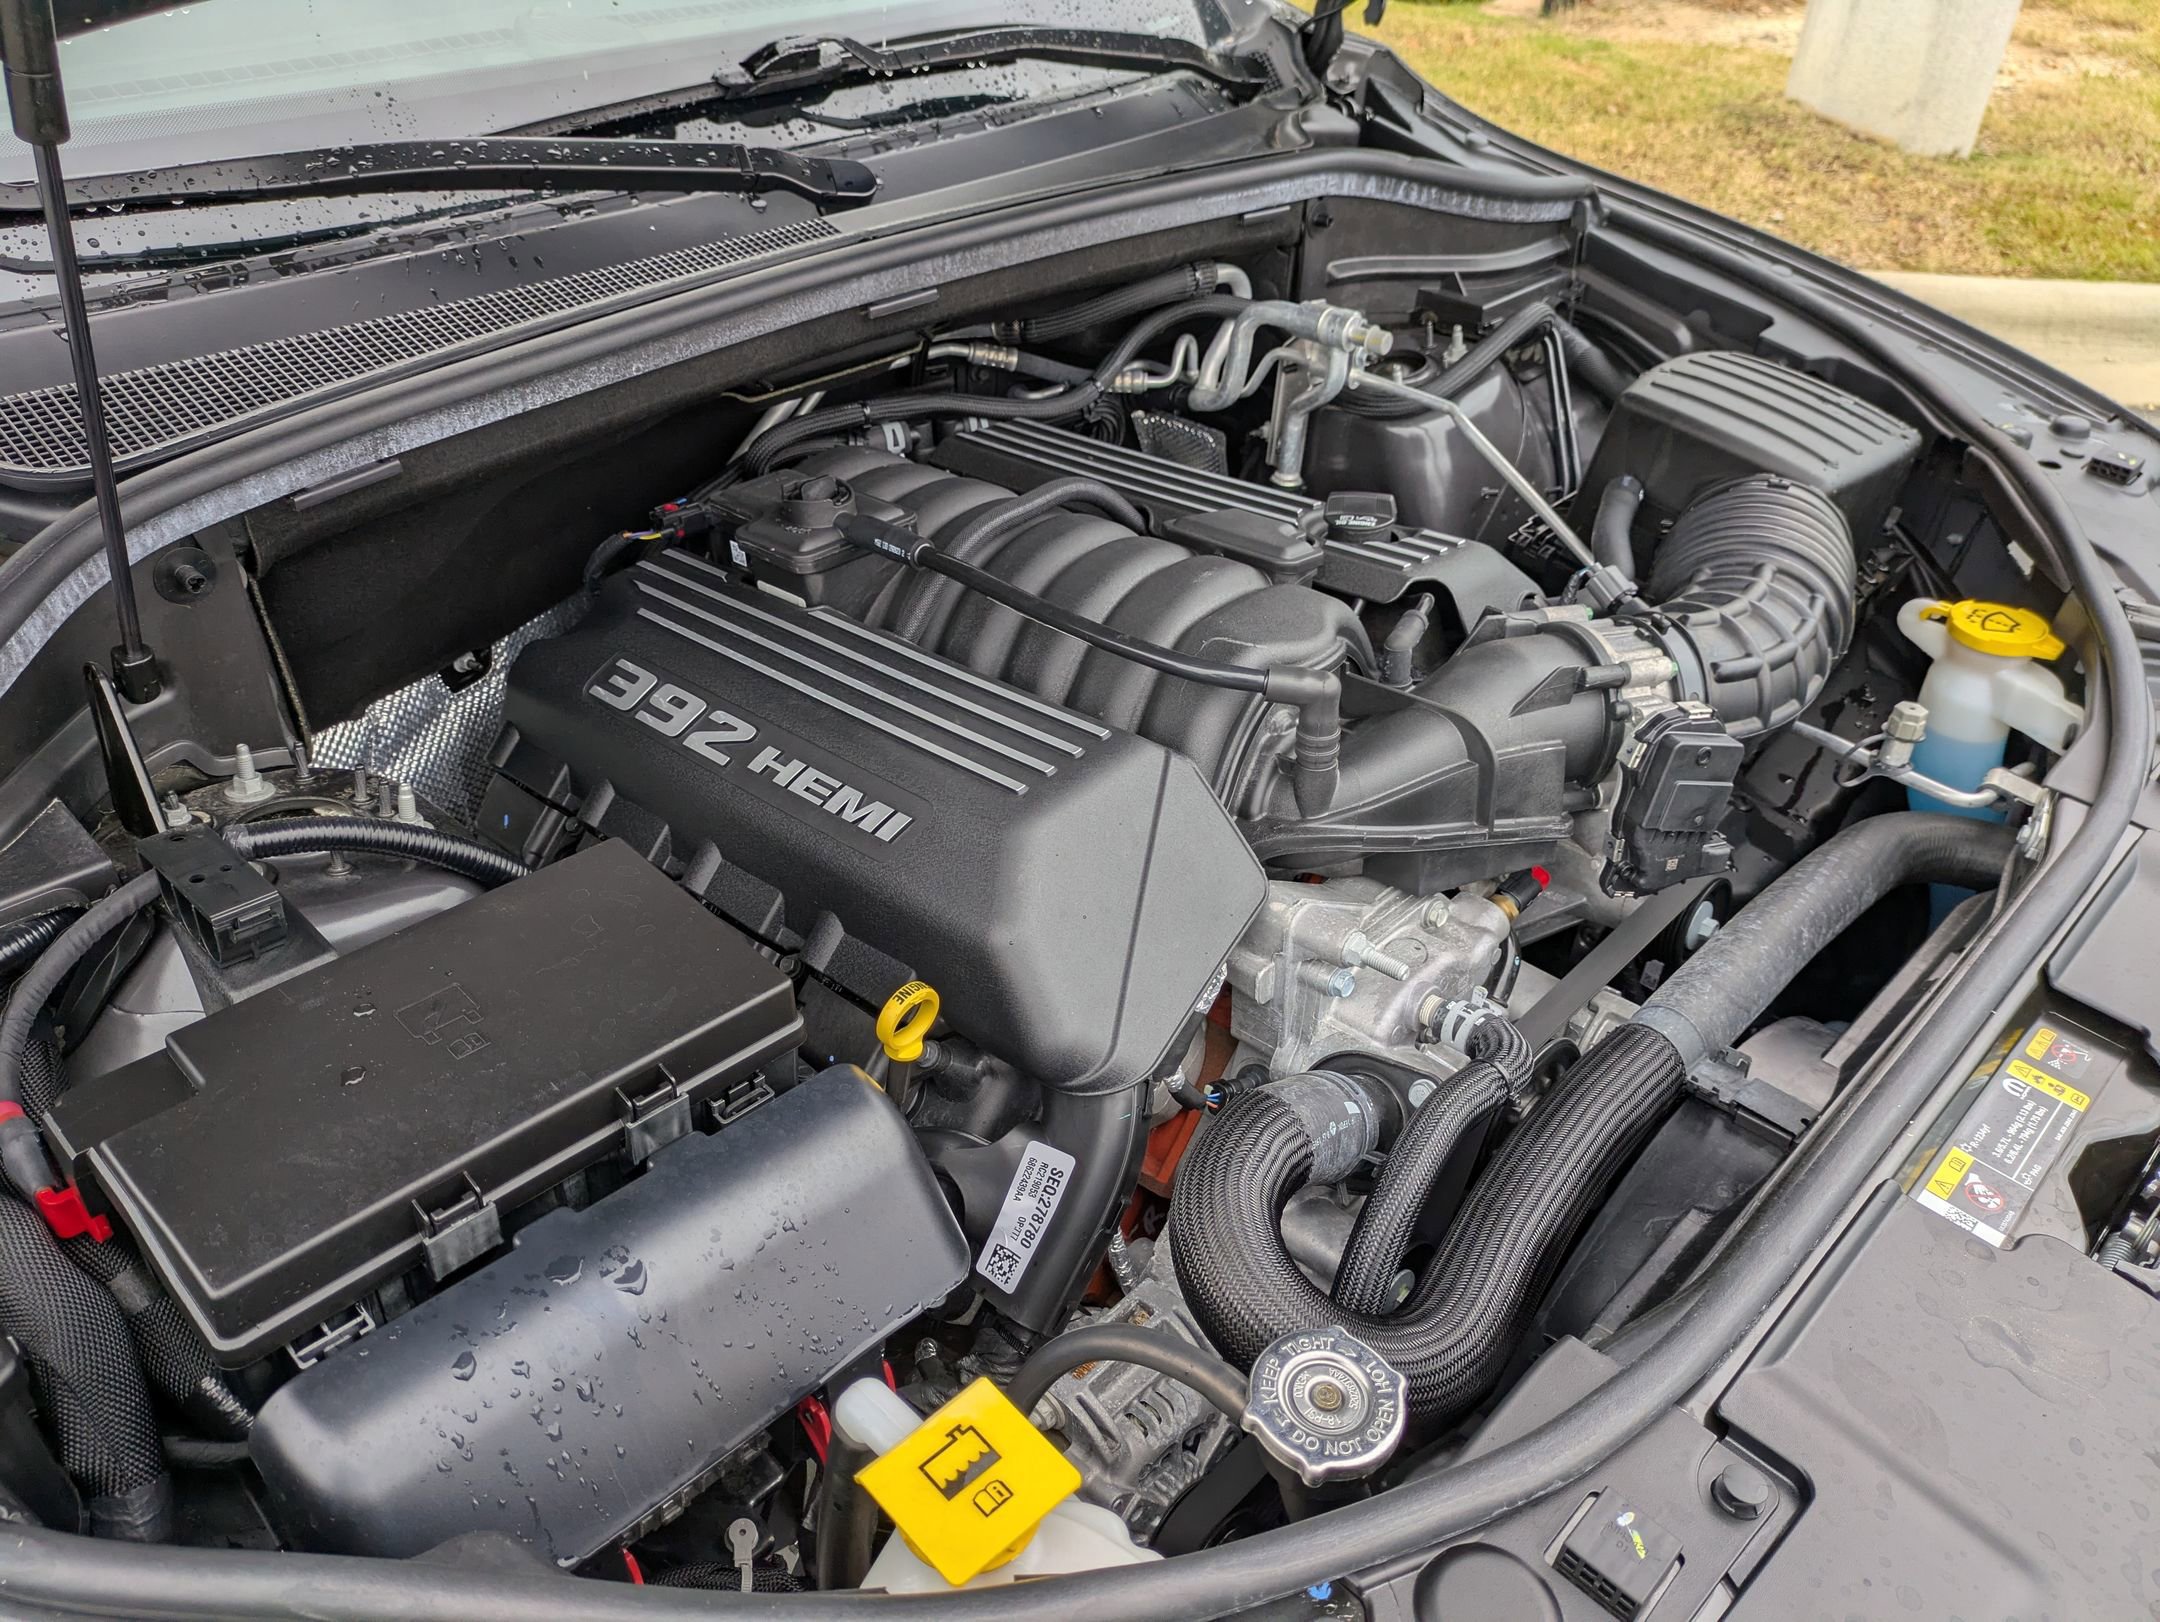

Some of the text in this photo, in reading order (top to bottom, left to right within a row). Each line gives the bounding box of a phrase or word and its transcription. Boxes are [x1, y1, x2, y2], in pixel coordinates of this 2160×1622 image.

[588, 658, 913, 842] 392 HEMI
[1013, 1157, 1038, 1202] 68622439AA
[1020, 1167, 1064, 1249] SEQ:278780
[1028, 1162, 1049, 1198] RC219053
[1260, 1336, 1335, 1404] KEEP TIGHT
[1289, 1361, 1396, 1456] DO NOT OPEN HOT
[1304, 1407, 1342, 1426] 18-PSI
